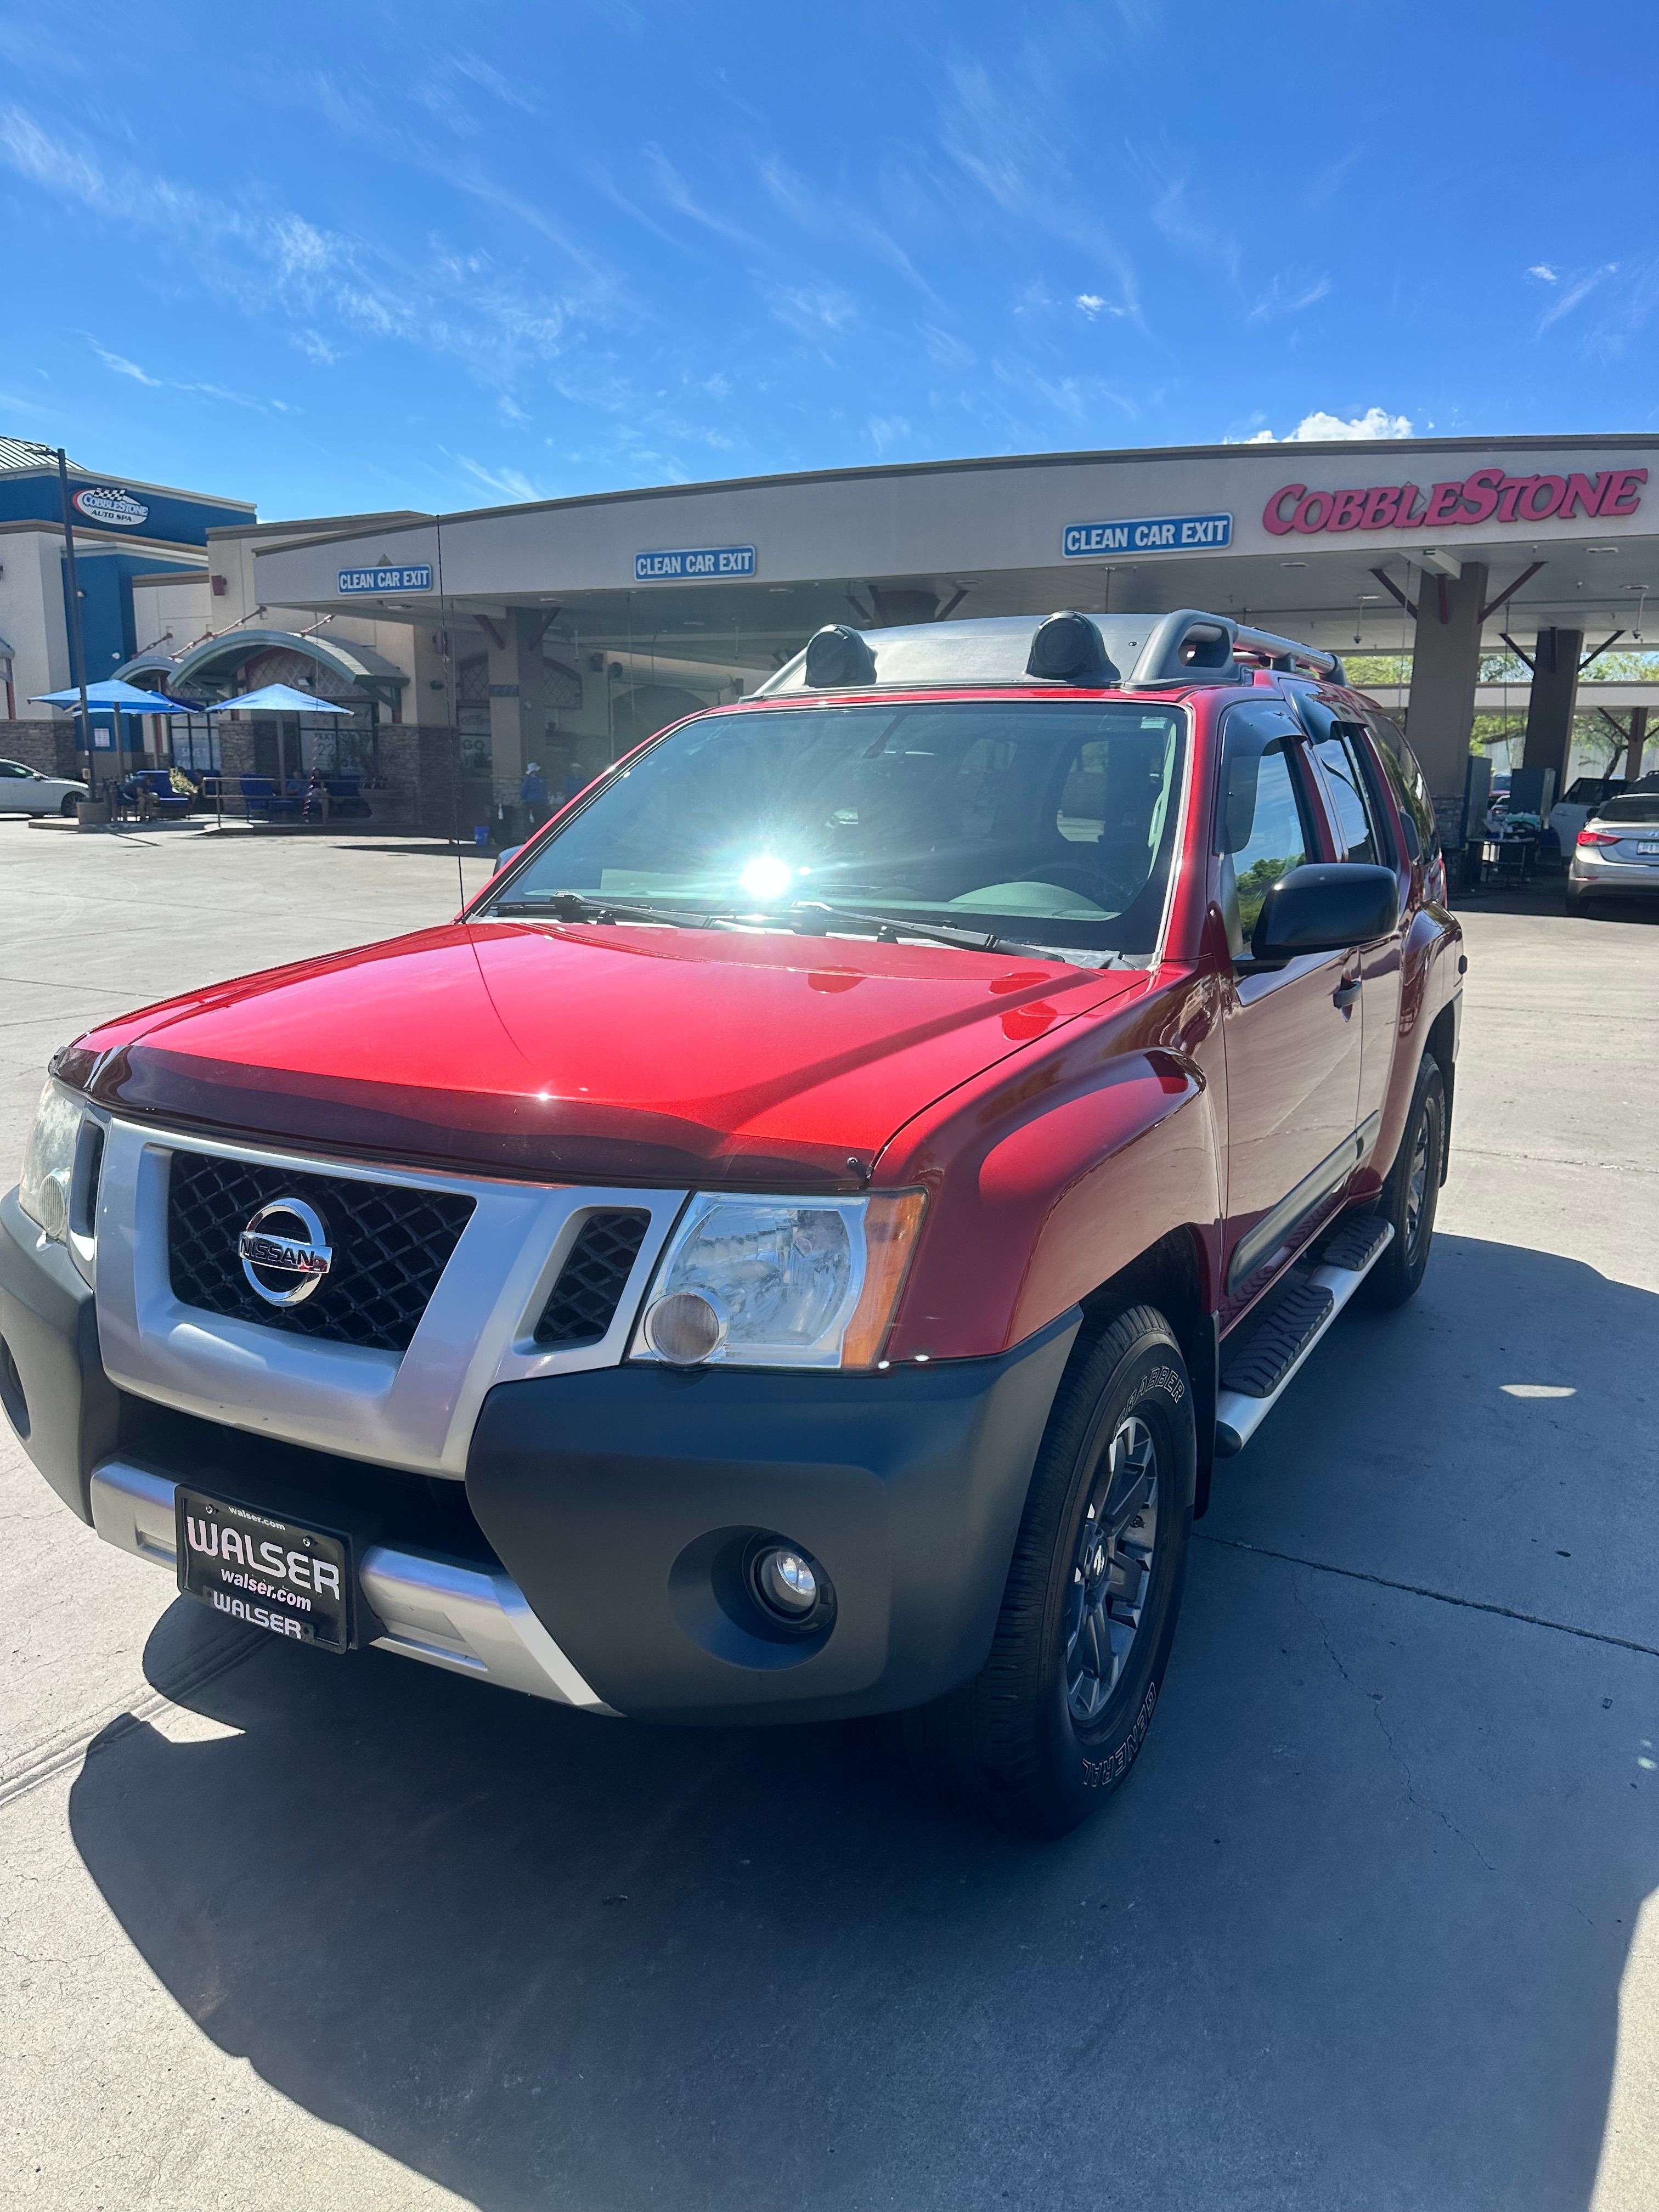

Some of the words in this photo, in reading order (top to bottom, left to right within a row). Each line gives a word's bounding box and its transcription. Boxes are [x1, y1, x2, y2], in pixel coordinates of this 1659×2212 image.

[83, 493, 149, 516] COBBLESTONE
[92, 510, 114, 518] AUTO
[116, 514, 132, 522] SPA
[1261, 468, 1648, 536] COBBLESTONE
[1066, 527, 1128, 551] CLEAN
[1135, 524, 1176, 546] CAR
[1181, 521, 1228, 543] EXIT
[637, 556, 681, 575] CLEAN
[686, 555, 715, 573] CAR
[719, 552, 752, 571] EXIT
[340, 573, 375, 589] CLEAN
[377, 572, 400, 588] CAR
[403, 569, 428, 586] EXIT
[240, 1238, 315, 1268] NISSAN
[228, 1506, 286, 1531] walser.com
[187, 1516, 340, 1600] WALSER
[221, 1567, 312, 1612] walser.com
[213, 1590, 302, 1639] WALSER
[1082, 1681, 1156, 1787] GENERAL
